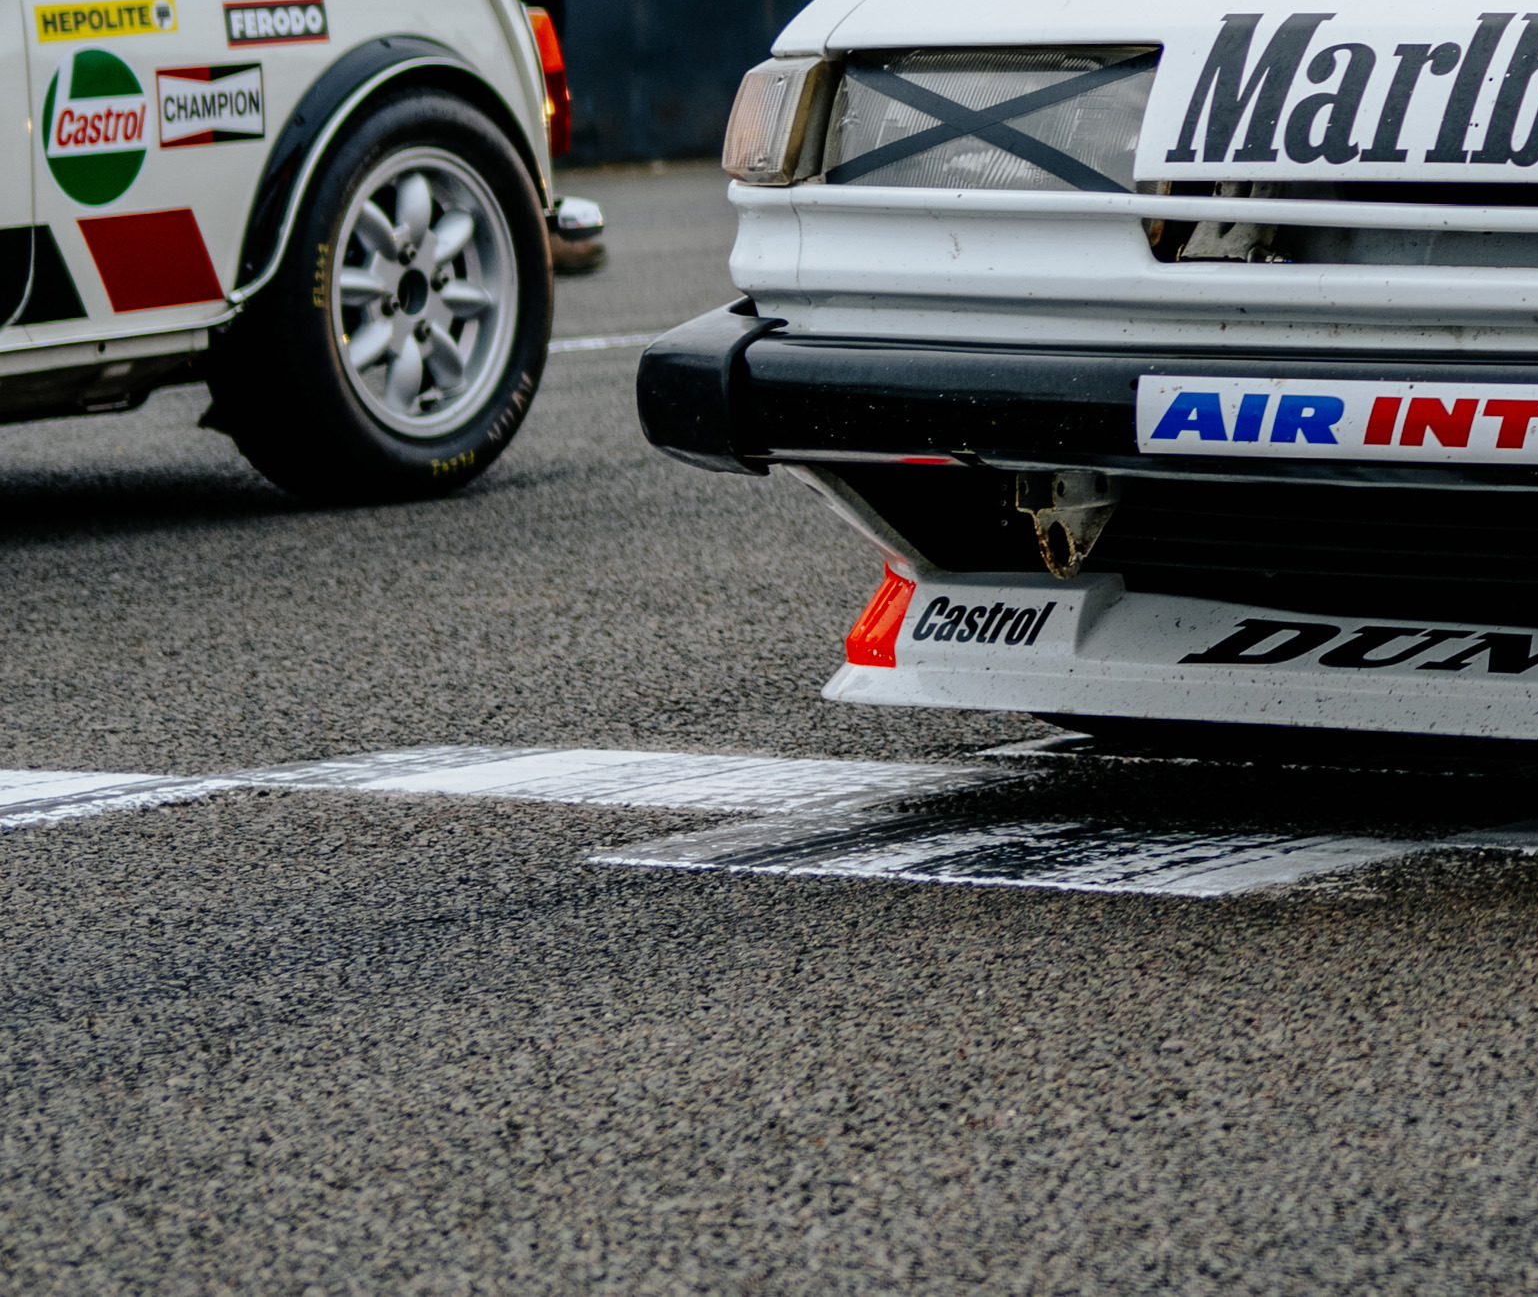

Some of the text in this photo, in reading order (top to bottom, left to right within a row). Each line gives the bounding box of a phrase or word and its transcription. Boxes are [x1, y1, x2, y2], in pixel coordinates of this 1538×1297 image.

[41, 5, 152, 35] HEPOLITE
[228, 5, 323, 40] FERODO
[163, 88, 261, 122] CHAMPION
[56, 103, 147, 148] Castrol
[1151, 392, 1346, 445] AIR
[912, 596, 1057, 647] Castrol
